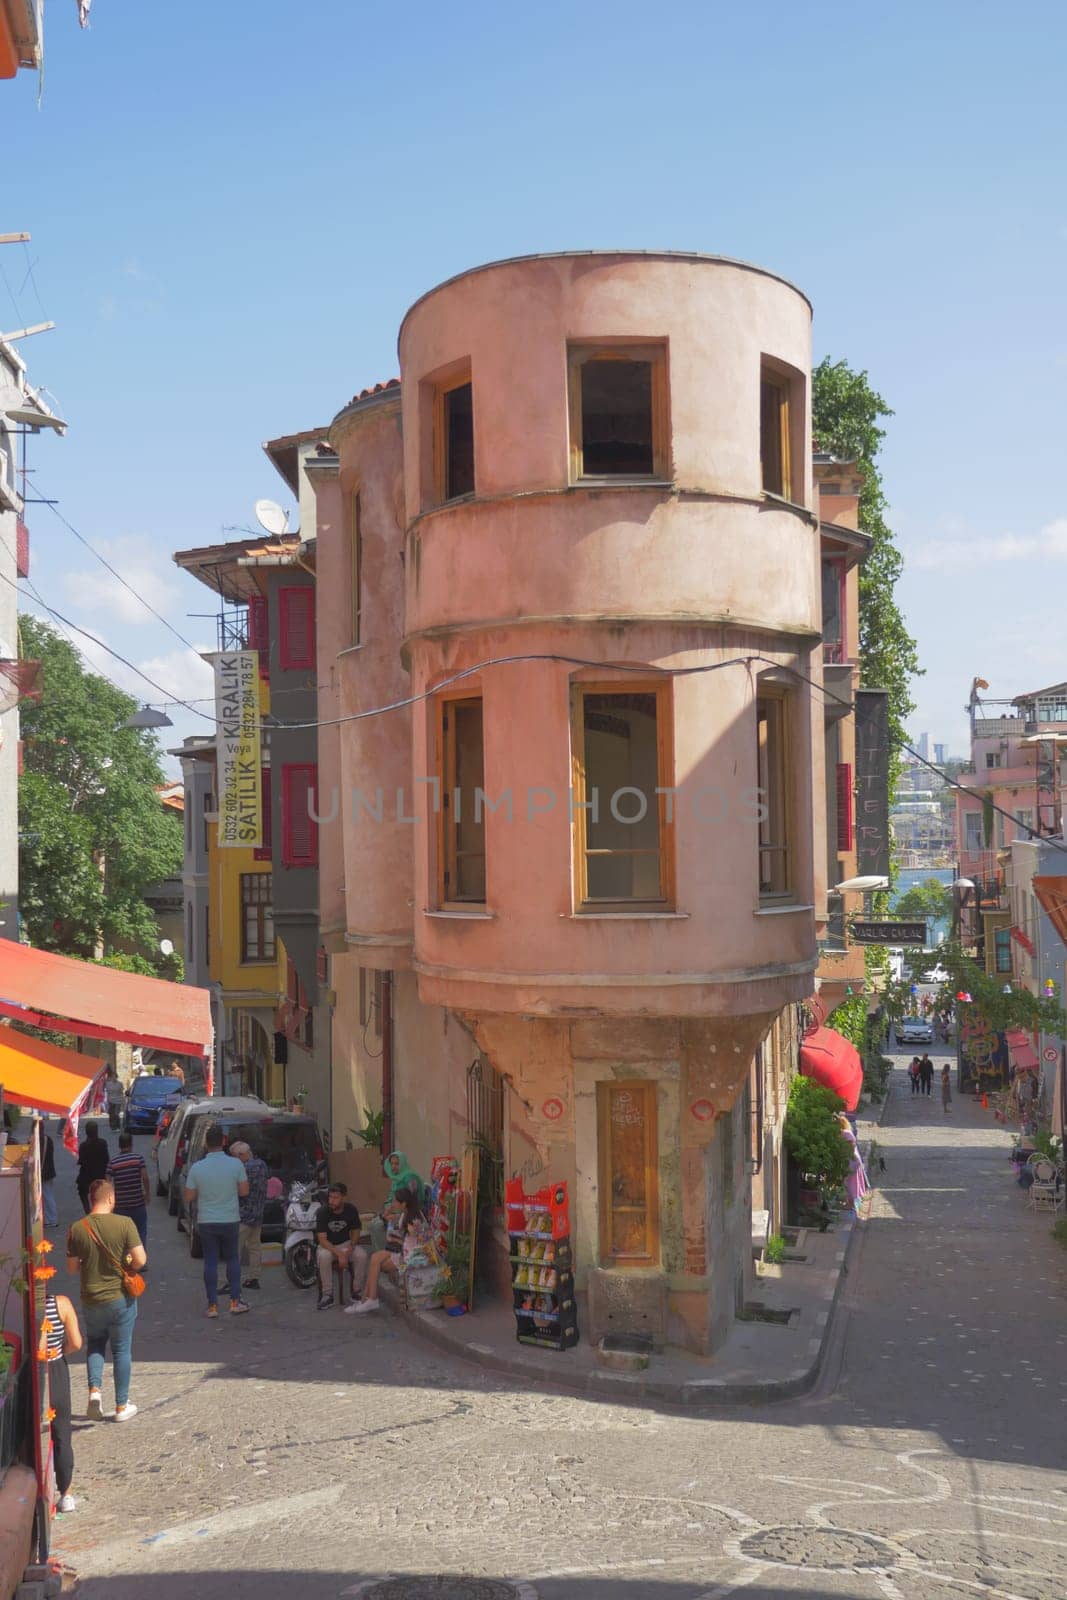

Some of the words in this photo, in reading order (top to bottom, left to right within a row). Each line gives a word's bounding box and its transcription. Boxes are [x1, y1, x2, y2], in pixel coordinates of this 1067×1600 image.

[240, 656, 254, 669] 57
[241, 673, 254, 686] 78
[220, 657, 240, 739] KIRALIK
[224, 760, 237, 773] 34
[224, 793, 237, 812] 602
[238, 759, 257, 841] SATILIK
[224, 815, 237, 840] 0532
